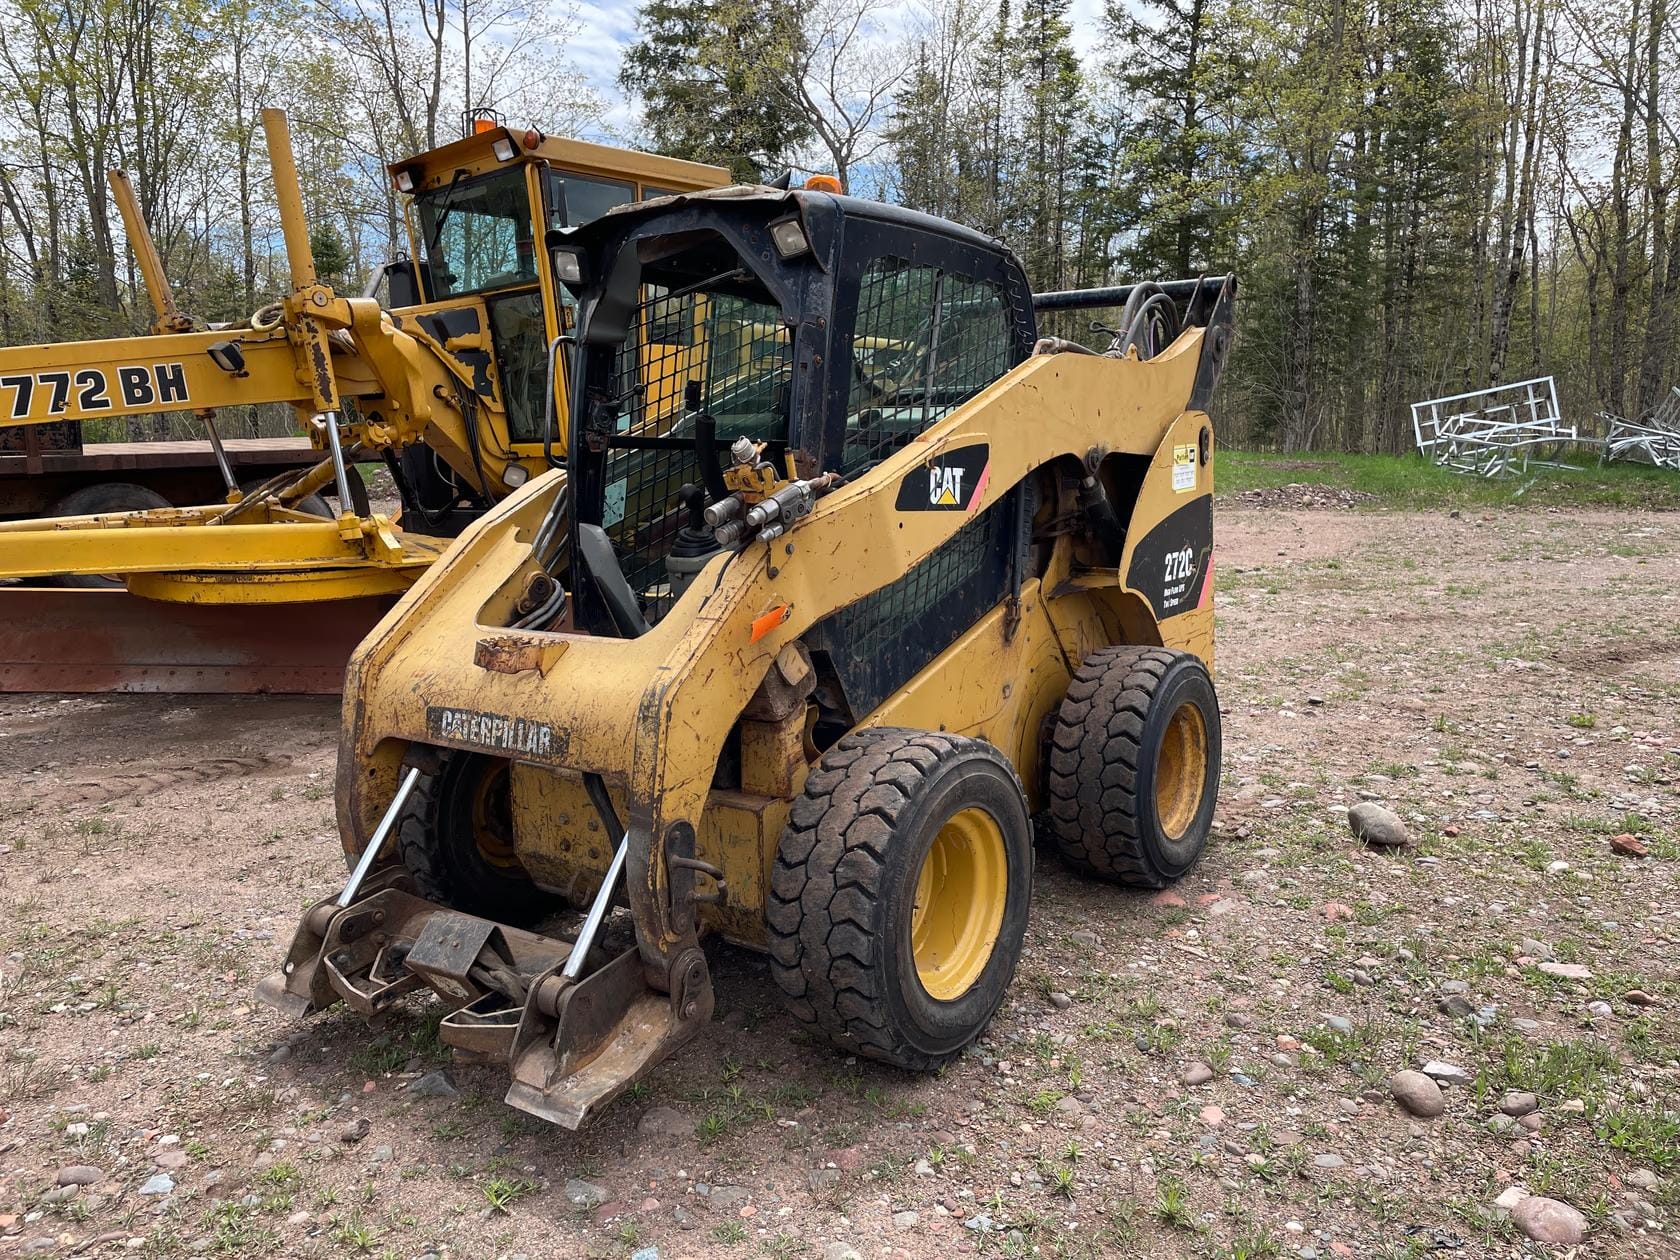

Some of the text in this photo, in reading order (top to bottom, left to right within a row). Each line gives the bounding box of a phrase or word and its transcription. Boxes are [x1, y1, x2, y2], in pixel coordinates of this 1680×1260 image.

[0, 362, 190, 419] 772 BH
[929, 466, 962, 505] CAT
[1164, 547, 1193, 582] 272C
[441, 710, 551, 755] CATERPILLAR
